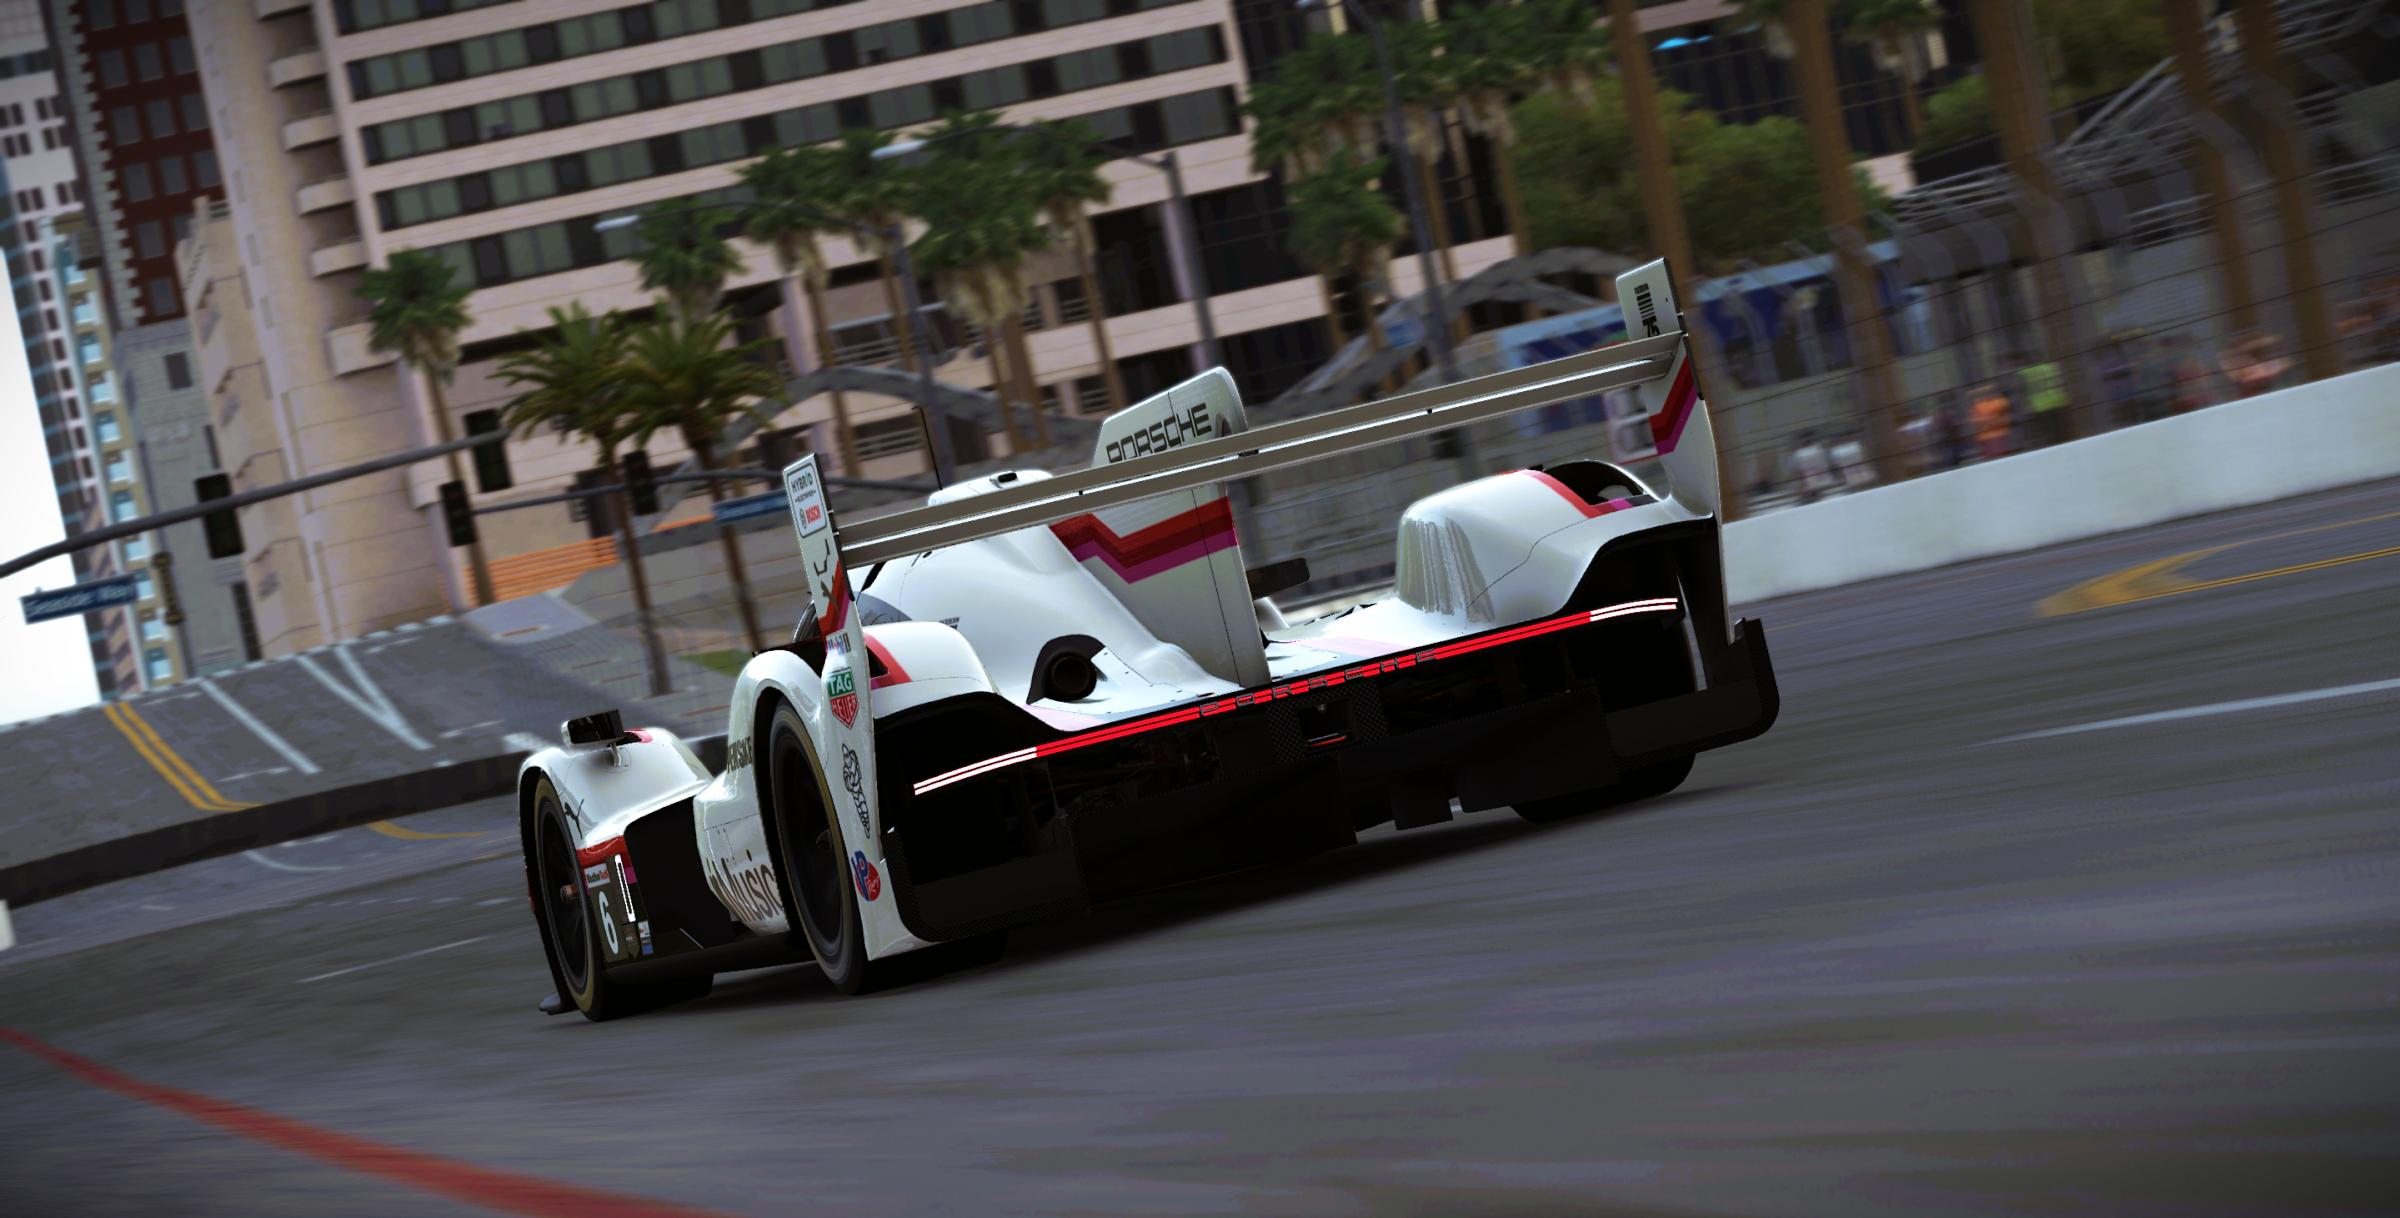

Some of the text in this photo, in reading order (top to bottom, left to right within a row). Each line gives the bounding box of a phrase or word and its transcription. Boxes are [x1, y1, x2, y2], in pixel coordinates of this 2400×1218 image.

[1106, 403, 1212, 464] PORSCHE
[828, 675, 853, 695] TAG
[832, 694, 857, 722] HEUER
[1200, 649, 1436, 717] PORSCHE
[598, 891, 619, 955] 6
